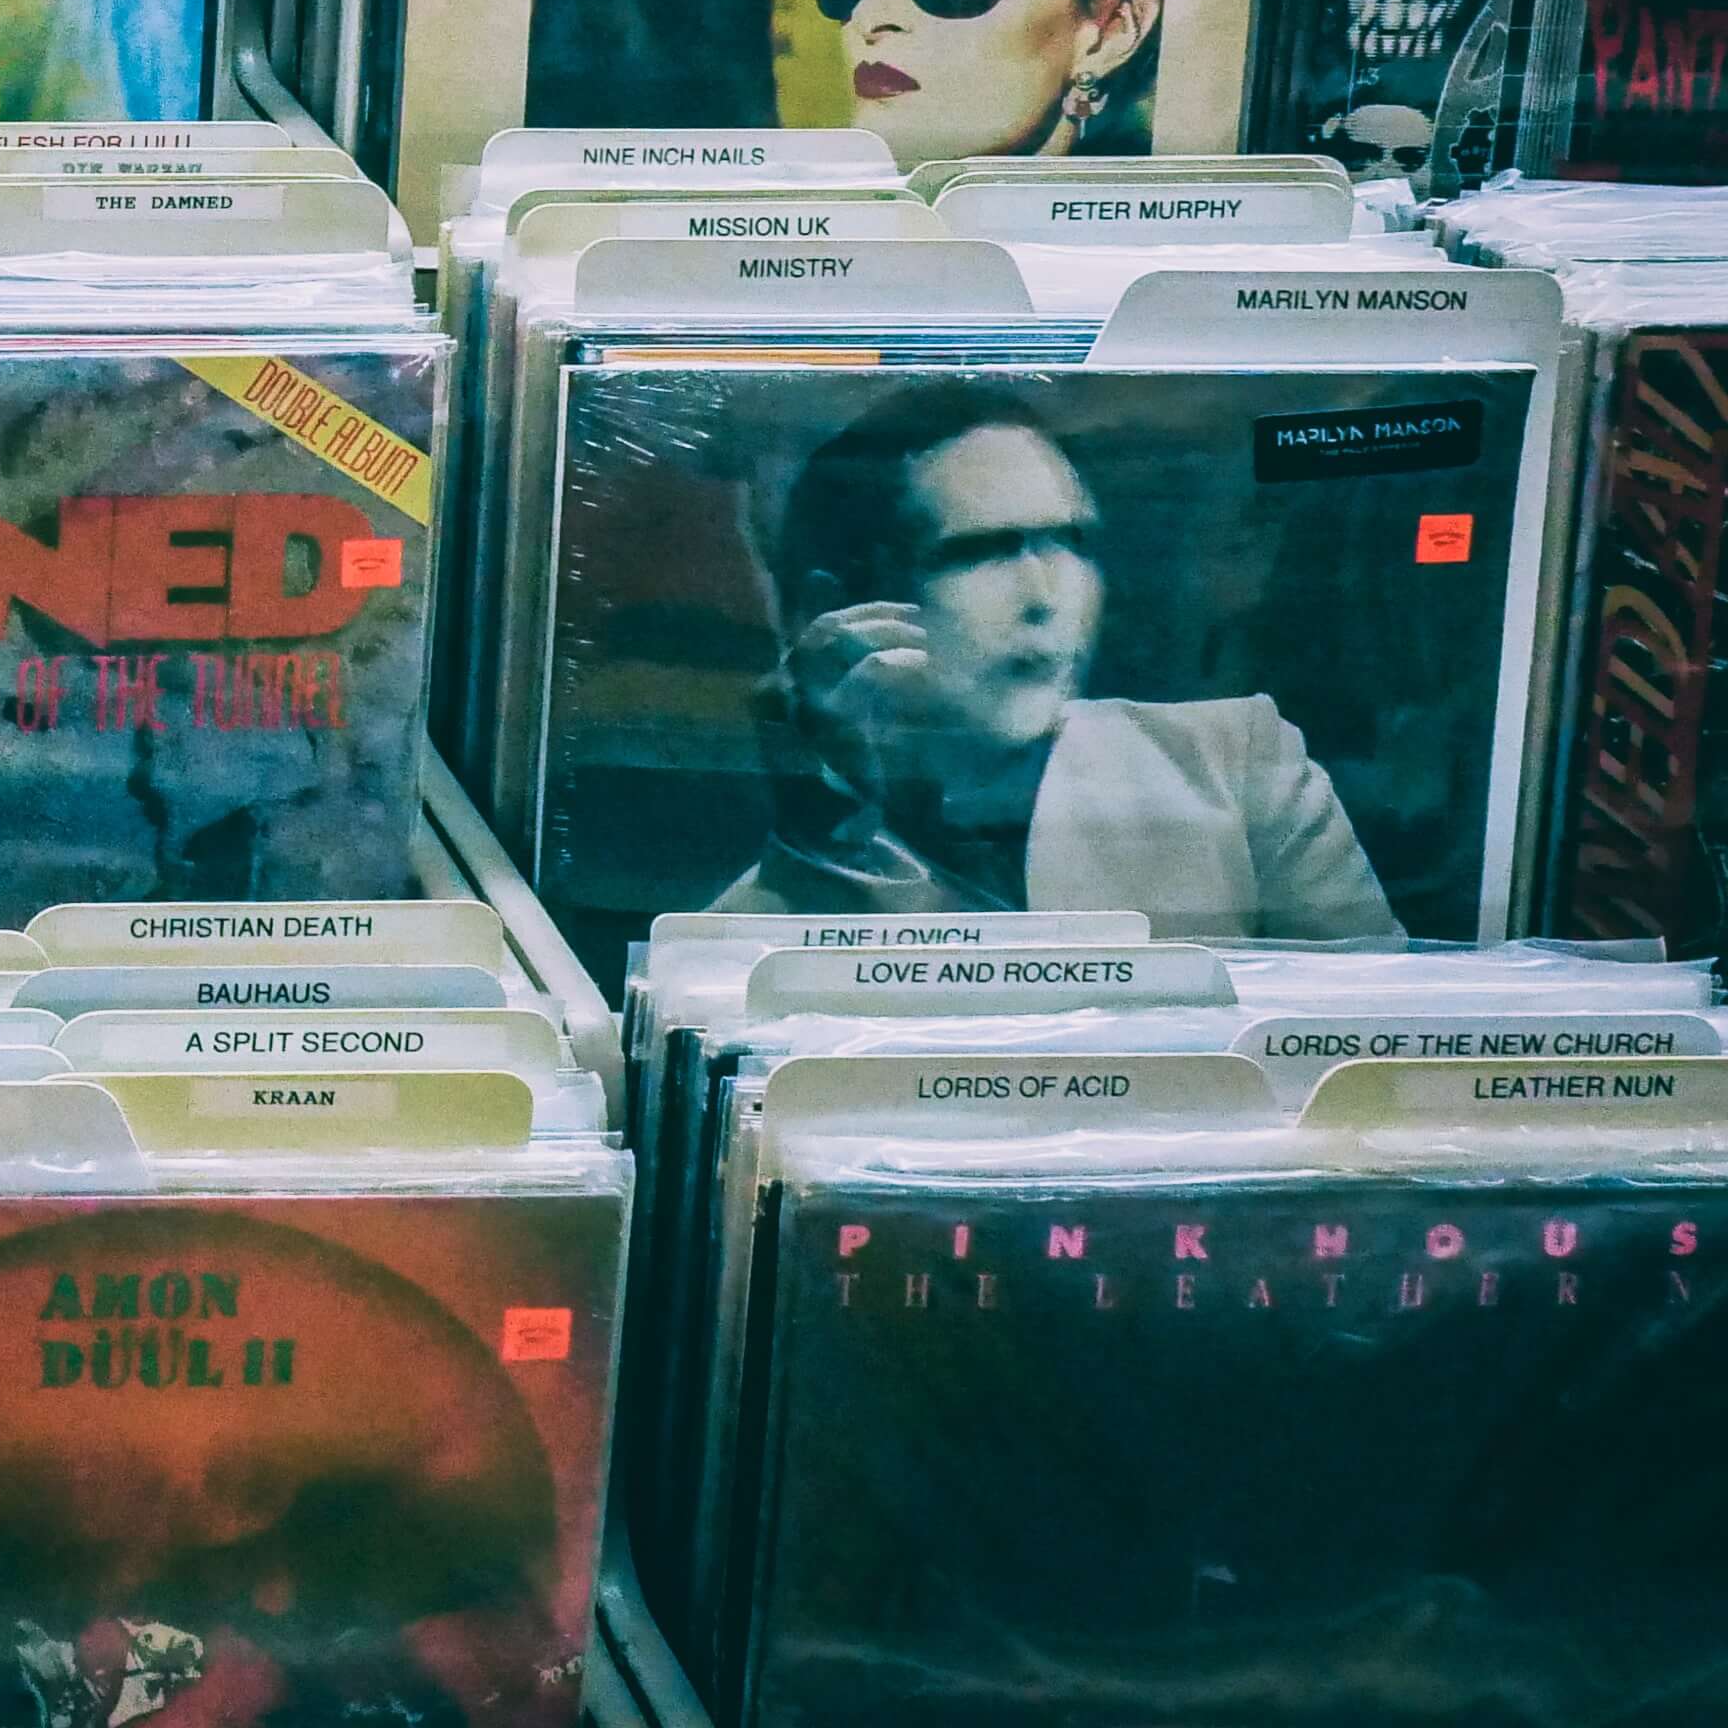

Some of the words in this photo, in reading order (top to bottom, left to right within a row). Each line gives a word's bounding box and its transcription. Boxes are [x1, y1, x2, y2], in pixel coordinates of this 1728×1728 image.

[583, 147, 635, 166] NINE
[642, 147, 694, 166] INCH
[702, 147, 765, 166] NAILS
[96, 195, 137, 210] THE
[150, 194, 233, 211] DAMNED
[1052, 202, 1130, 222] PETER
[1139, 200, 1242, 221] MURPHY
[689, 217, 787, 236] MISSION
[796, 216, 830, 236] UK
[739, 258, 853, 280] MINISTRY
[1237, 289, 1349, 311] MARILYN
[1357, 290, 1467, 311] MANSON
[253, 359, 341, 437] DOUBLE
[330, 410, 420, 496] ALBUM
[14, 656, 64, 734] OF
[91, 656, 169, 730] THE
[191, 653, 344, 729] TUNNEL
[130, 916, 272, 938] CHRISTIAN
[282, 916, 372, 938] DEATH
[855, 962, 931, 985] LOVE
[936, 961, 996, 984] AND
[1002, 961, 1133, 984] ROCKETS
[197, 982, 330, 1005] BAUHAUS
[185, 1033, 202, 1054] A
[211, 1032, 287, 1055] SPLIT
[297, 1032, 424, 1055] SECOND
[1264, 1035, 1363, 1057] LORDS
[1370, 1035, 1409, 1057] OF
[1417, 1034, 1473, 1056] THE
[1479, 1034, 1546, 1056] NEW
[1553, 1032, 1674, 1056] CHURCH
[252, 1090, 334, 1107] KRAAN
[917, 1077, 1014, 1099] LORDS
[1021, 1077, 1059, 1099] OF
[1063, 1077, 1130, 1099] ACID
[1474, 1077, 1605, 1101] LEATHER
[1611, 1077, 1675, 1097] NUN
[40, 1274, 241, 1321] AMON
